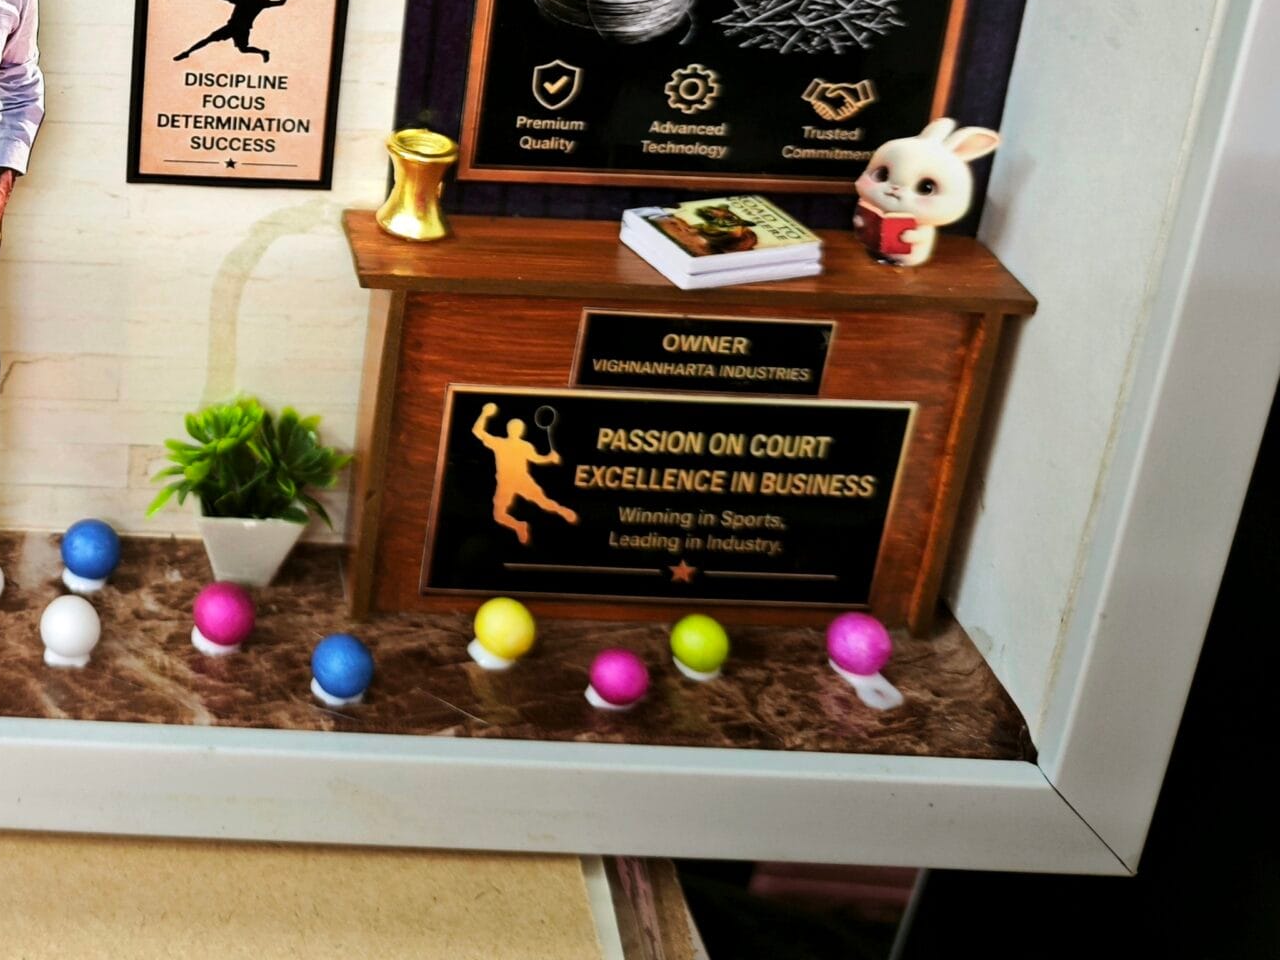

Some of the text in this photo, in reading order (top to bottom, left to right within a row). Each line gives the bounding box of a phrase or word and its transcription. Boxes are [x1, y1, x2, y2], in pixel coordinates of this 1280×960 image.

[184, 72, 288, 90] DISCIPLINE
[202, 94, 265, 110] FOCUS
[157, 113, 310, 133] DETERMINATION
[516, 115, 584, 132] Premium
[649, 120, 726, 137] Advanced
[801, 125, 861, 141] Trusted
[190, 136, 276, 153] SUCCESS
[519, 136, 575, 154] Quality
[641, 140, 728, 159] Technology
[662, 333, 749, 355] OWNER
[592, 358, 811, 382] VIGHNANHARTA INDUSTRIES
[596, 427, 832, 459] PASSION ON COURT
[574, 464, 875, 498] EXCELLENCE IN BUSINESS
[618, 506, 692, 528] Winning
[698, 509, 716, 526] in
[608, 531, 782, 555] Leading in Industry.
